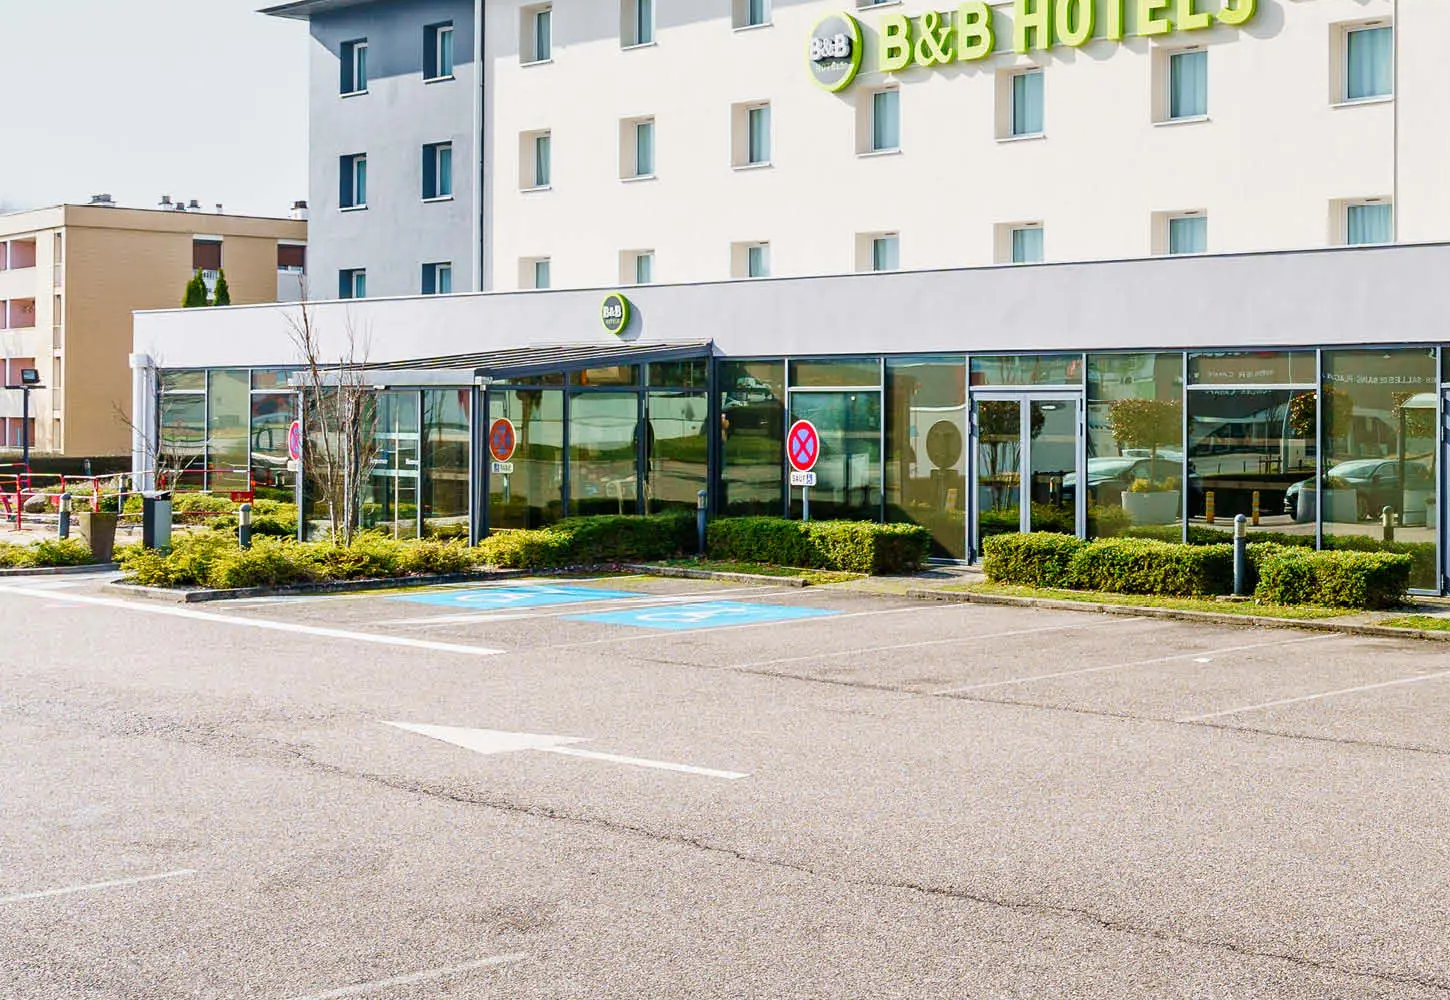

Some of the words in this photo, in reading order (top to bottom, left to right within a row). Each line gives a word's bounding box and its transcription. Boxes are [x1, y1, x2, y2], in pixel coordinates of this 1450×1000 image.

[810, 33, 850, 61] B&B
[878, 1, 995, 73] B&B
[602, 304, 622, 319] B&B
